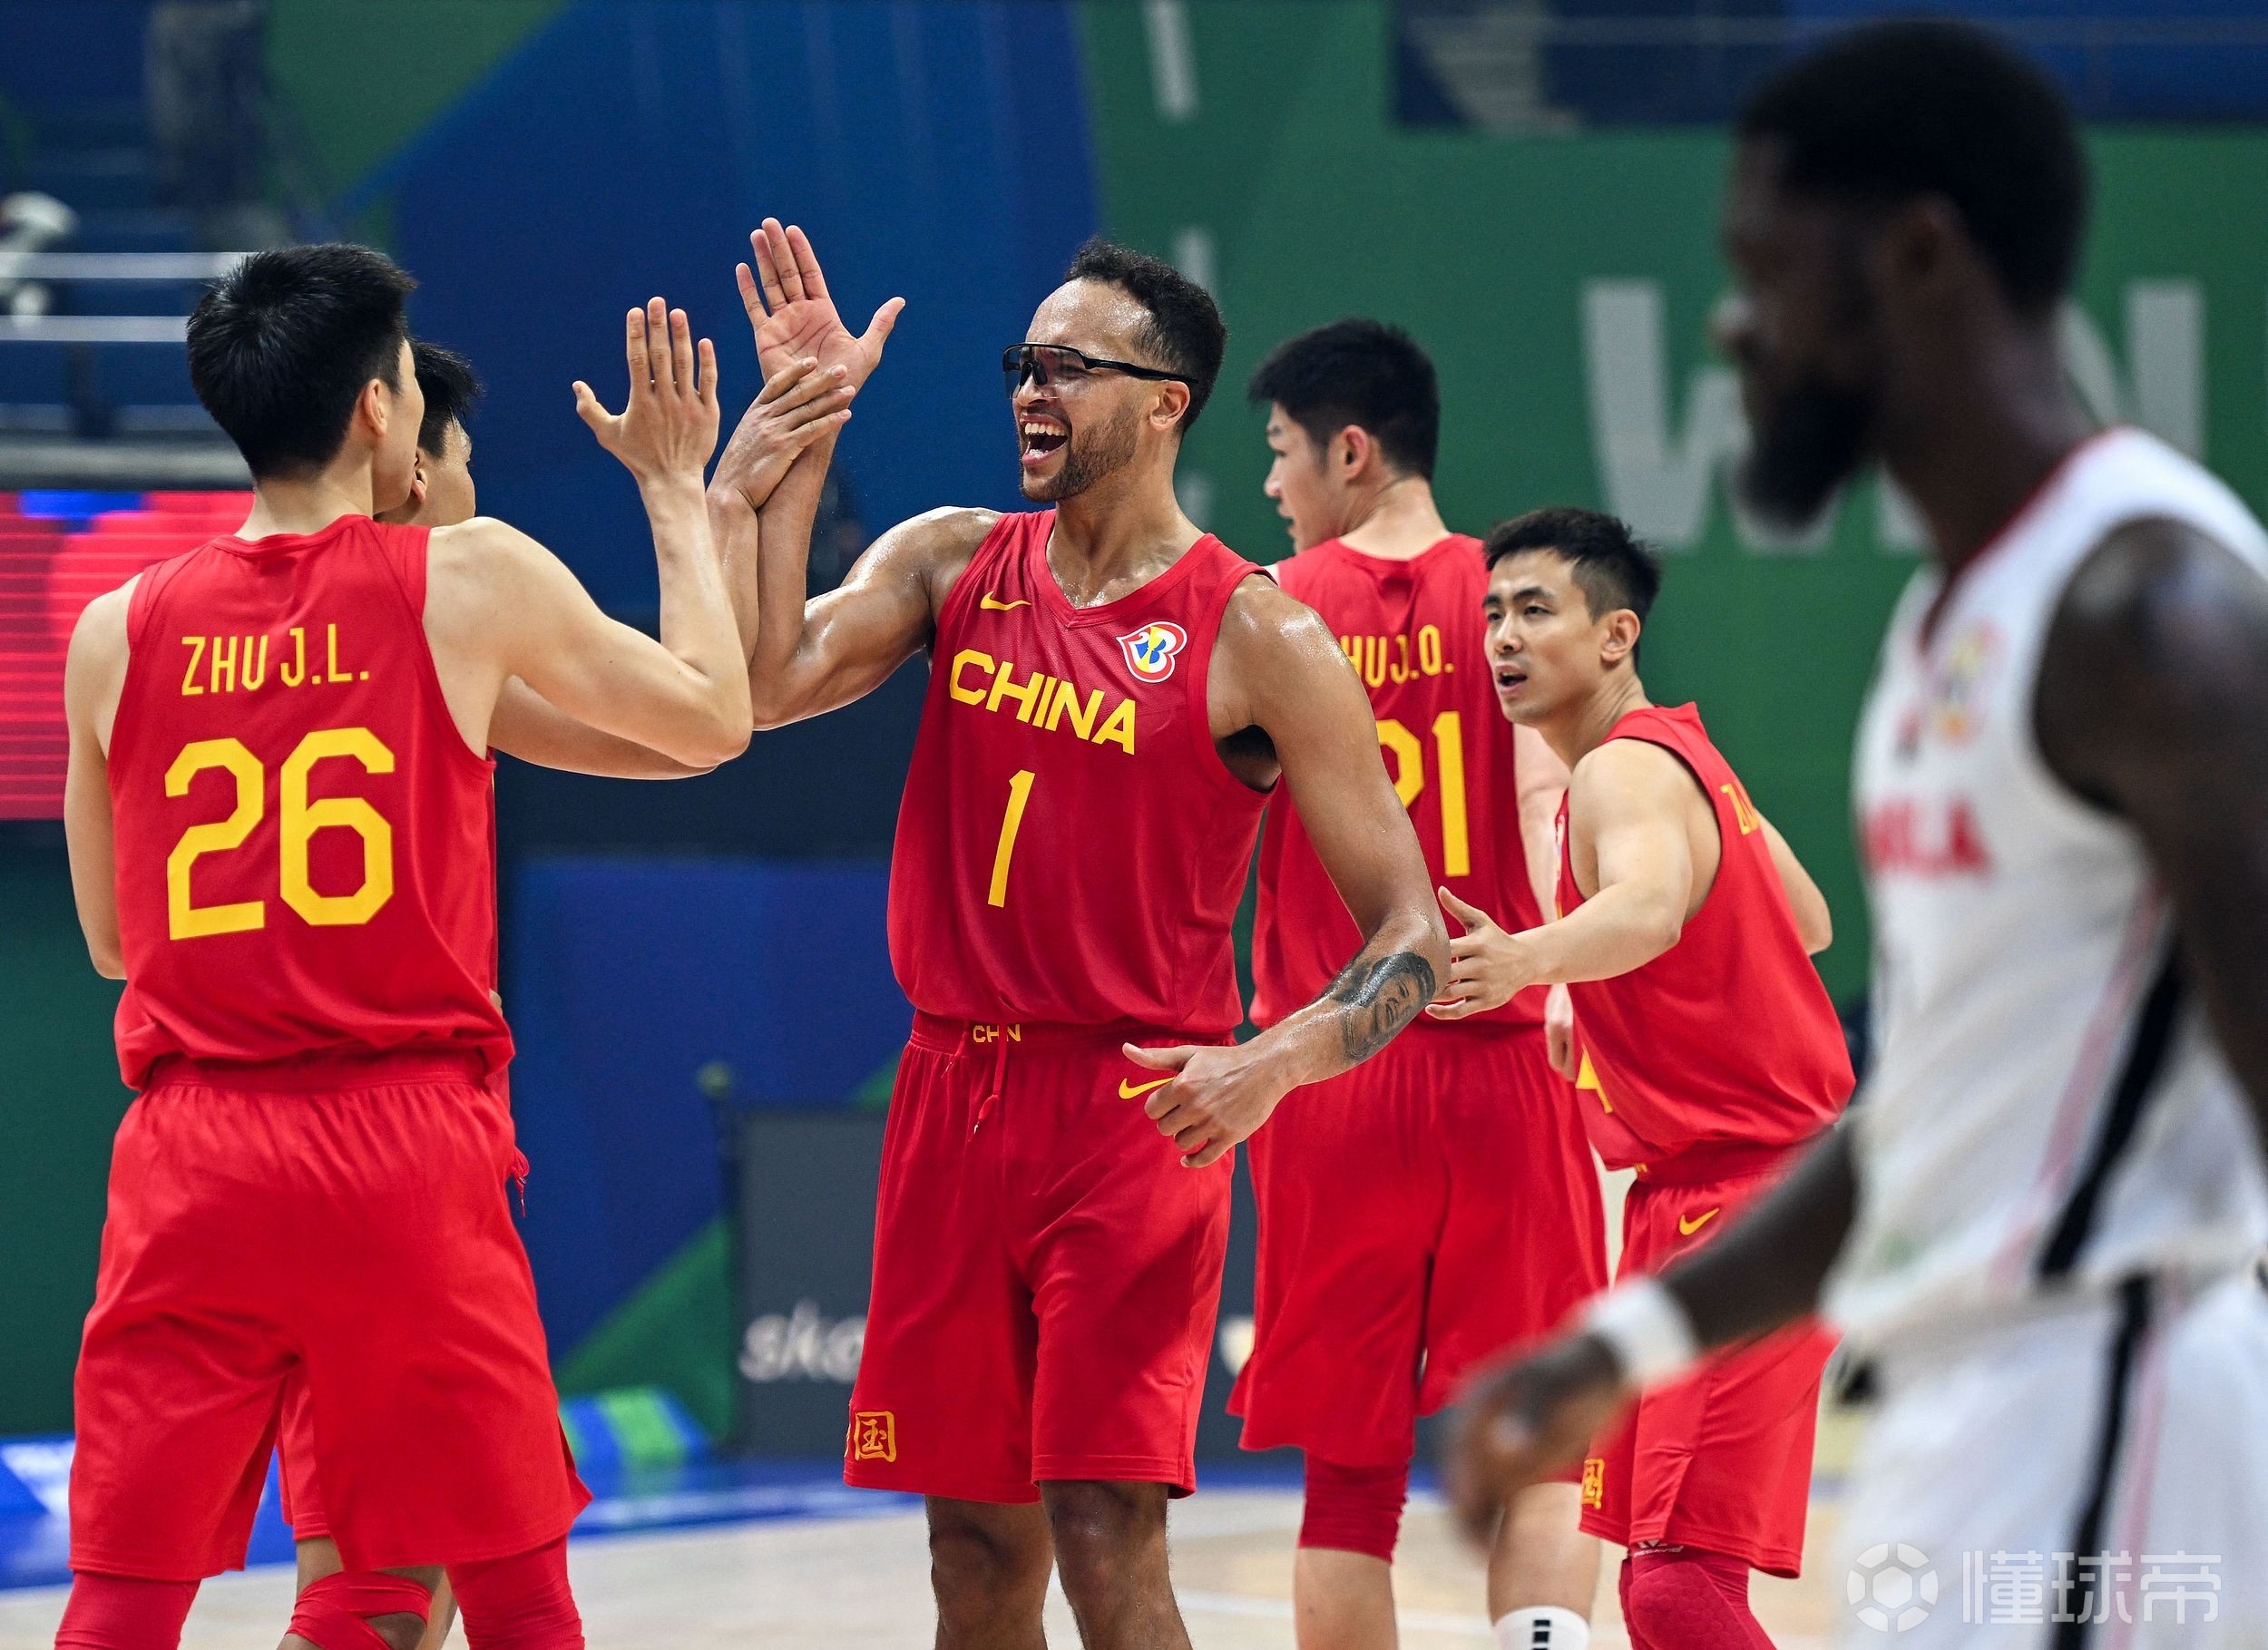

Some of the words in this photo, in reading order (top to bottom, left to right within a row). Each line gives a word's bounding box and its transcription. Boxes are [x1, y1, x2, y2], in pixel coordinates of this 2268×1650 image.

[181, 635, 269, 696] ZHU
[280, 623, 369, 688] J.L.
[1340, 635, 1388, 688] HU
[1390, 624, 1454, 685] J.O.
[949, 649, 1136, 755] CHINA
[164, 727, 395, 940] 26
[988, 769, 1035, 909] 1
[844, 1411, 897, 1462] 国
